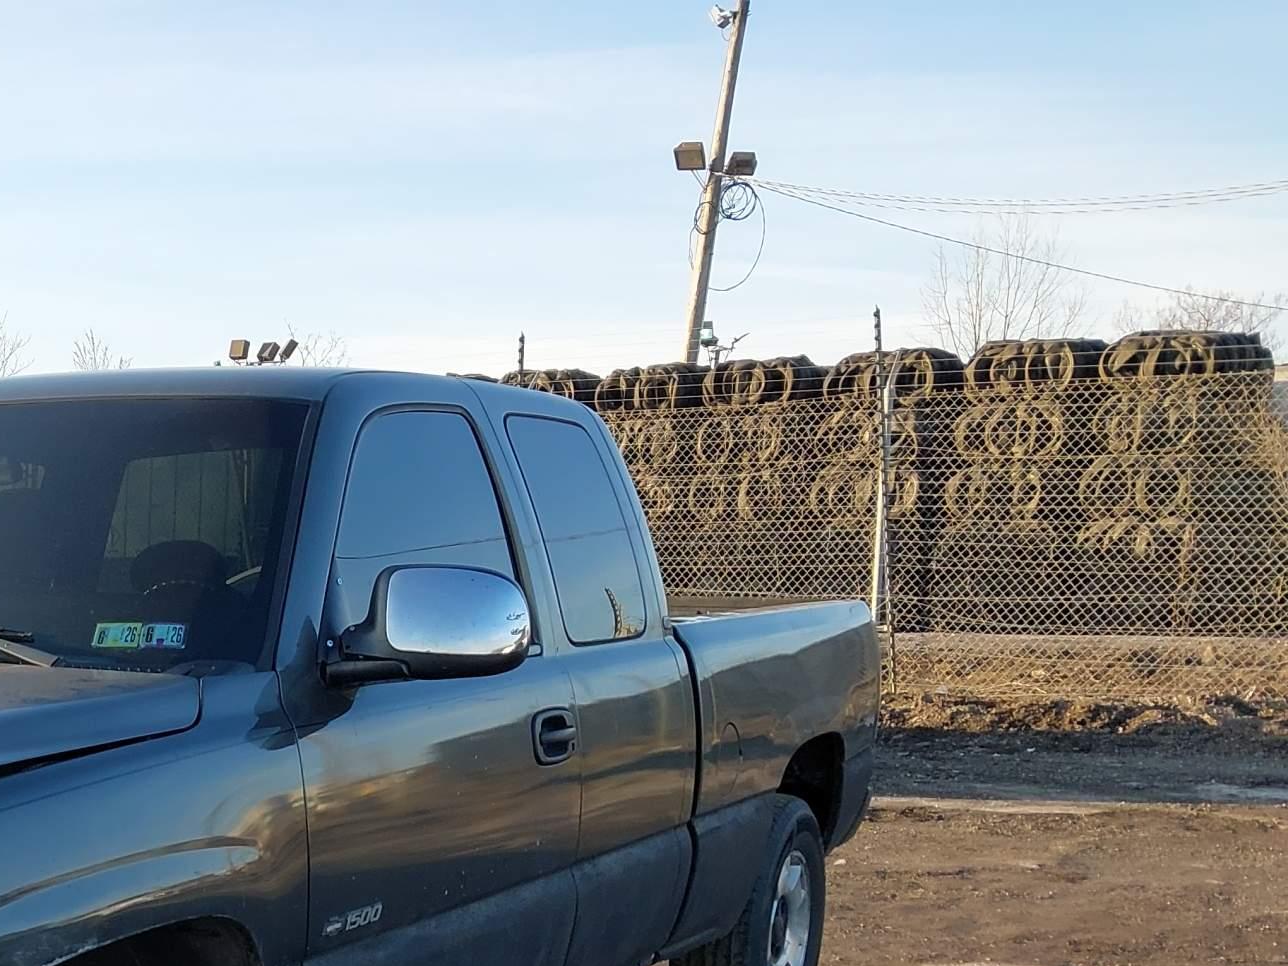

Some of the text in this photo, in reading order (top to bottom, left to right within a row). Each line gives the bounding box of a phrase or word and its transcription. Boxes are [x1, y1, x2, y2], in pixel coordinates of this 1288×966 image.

[124, 626, 137, 642] 26
[170, 626, 183, 643] 26
[345, 902, 383, 930] 1500
